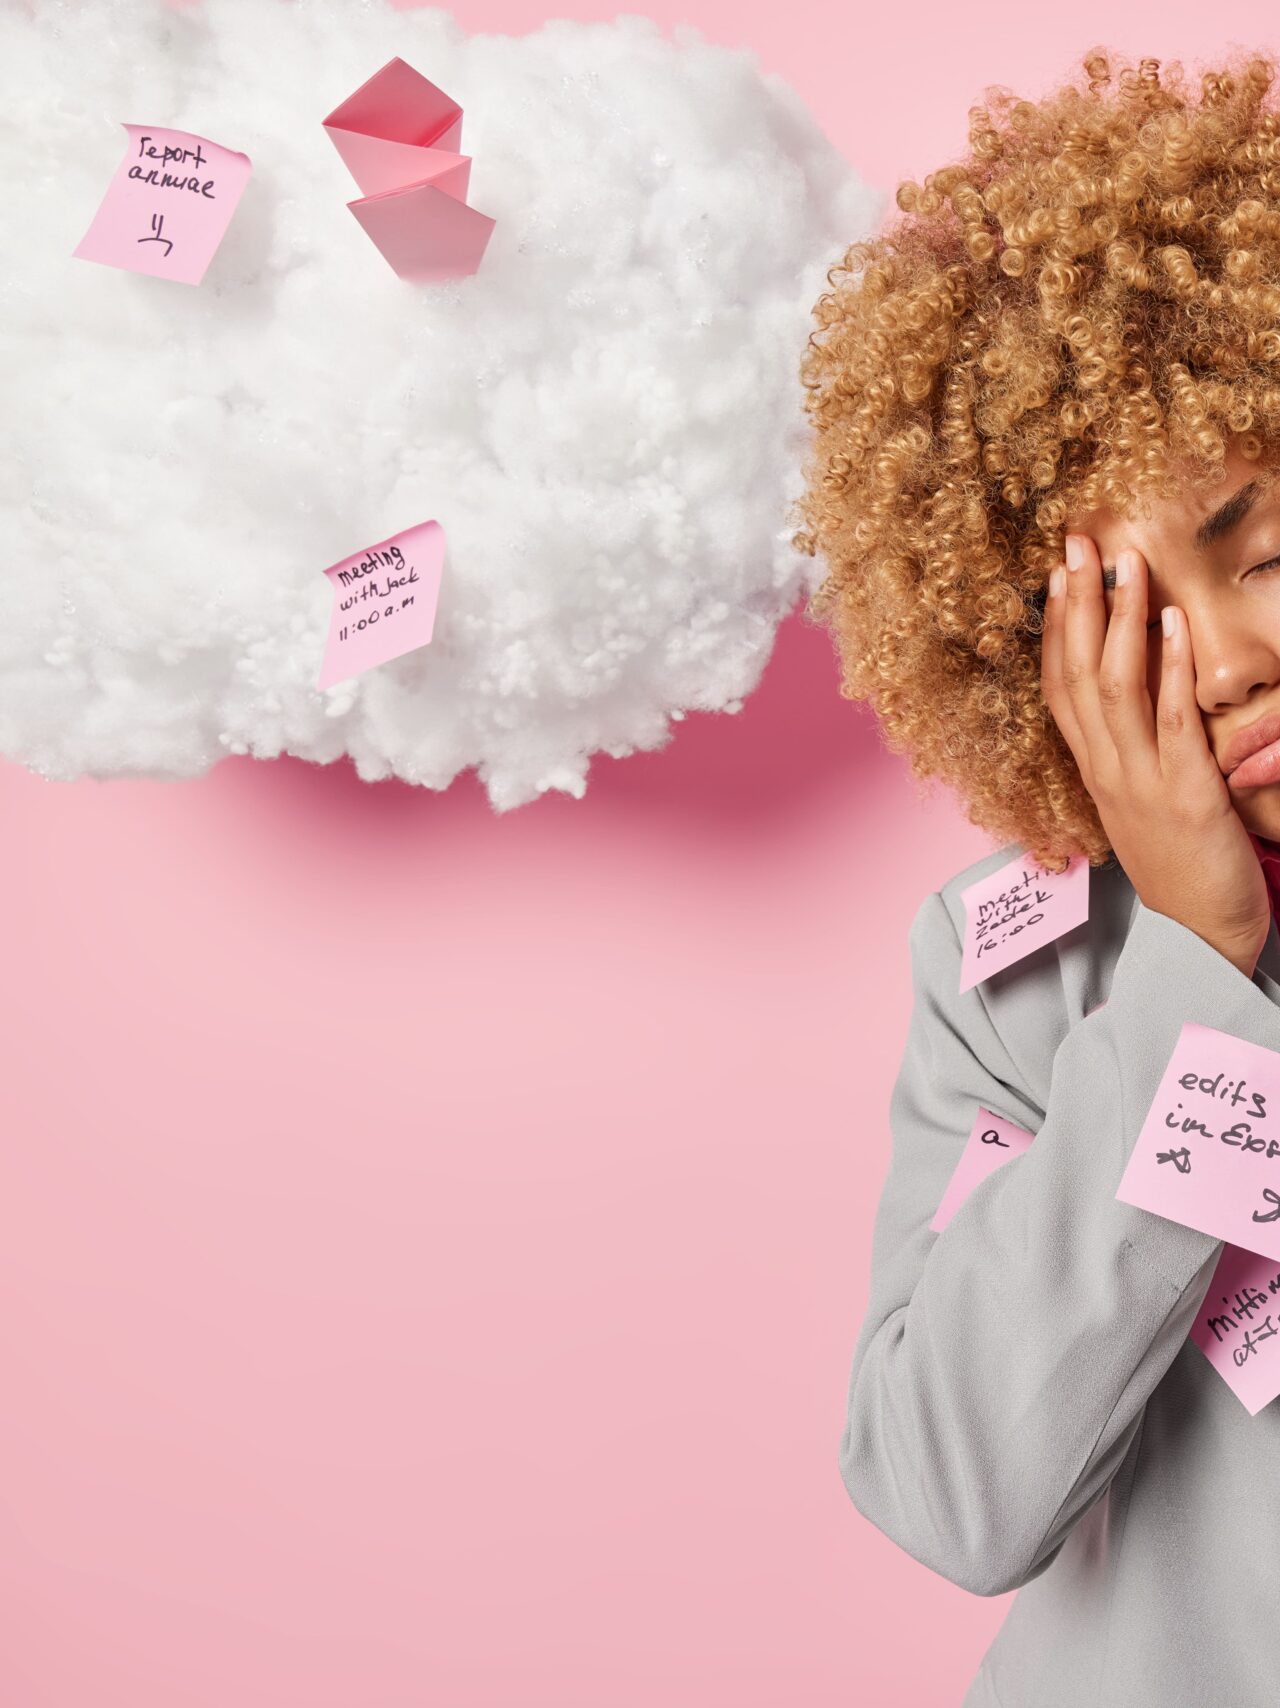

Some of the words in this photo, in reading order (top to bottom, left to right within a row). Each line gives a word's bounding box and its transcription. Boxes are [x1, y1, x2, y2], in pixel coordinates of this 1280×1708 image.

[139, 137, 207, 169] report
[337, 546, 405, 587] meeting
[340, 580, 378, 611] with
[339, 610, 380, 641] 11:00
[976, 892, 1032, 927] with
[976, 913, 1044, 958] 16:00
